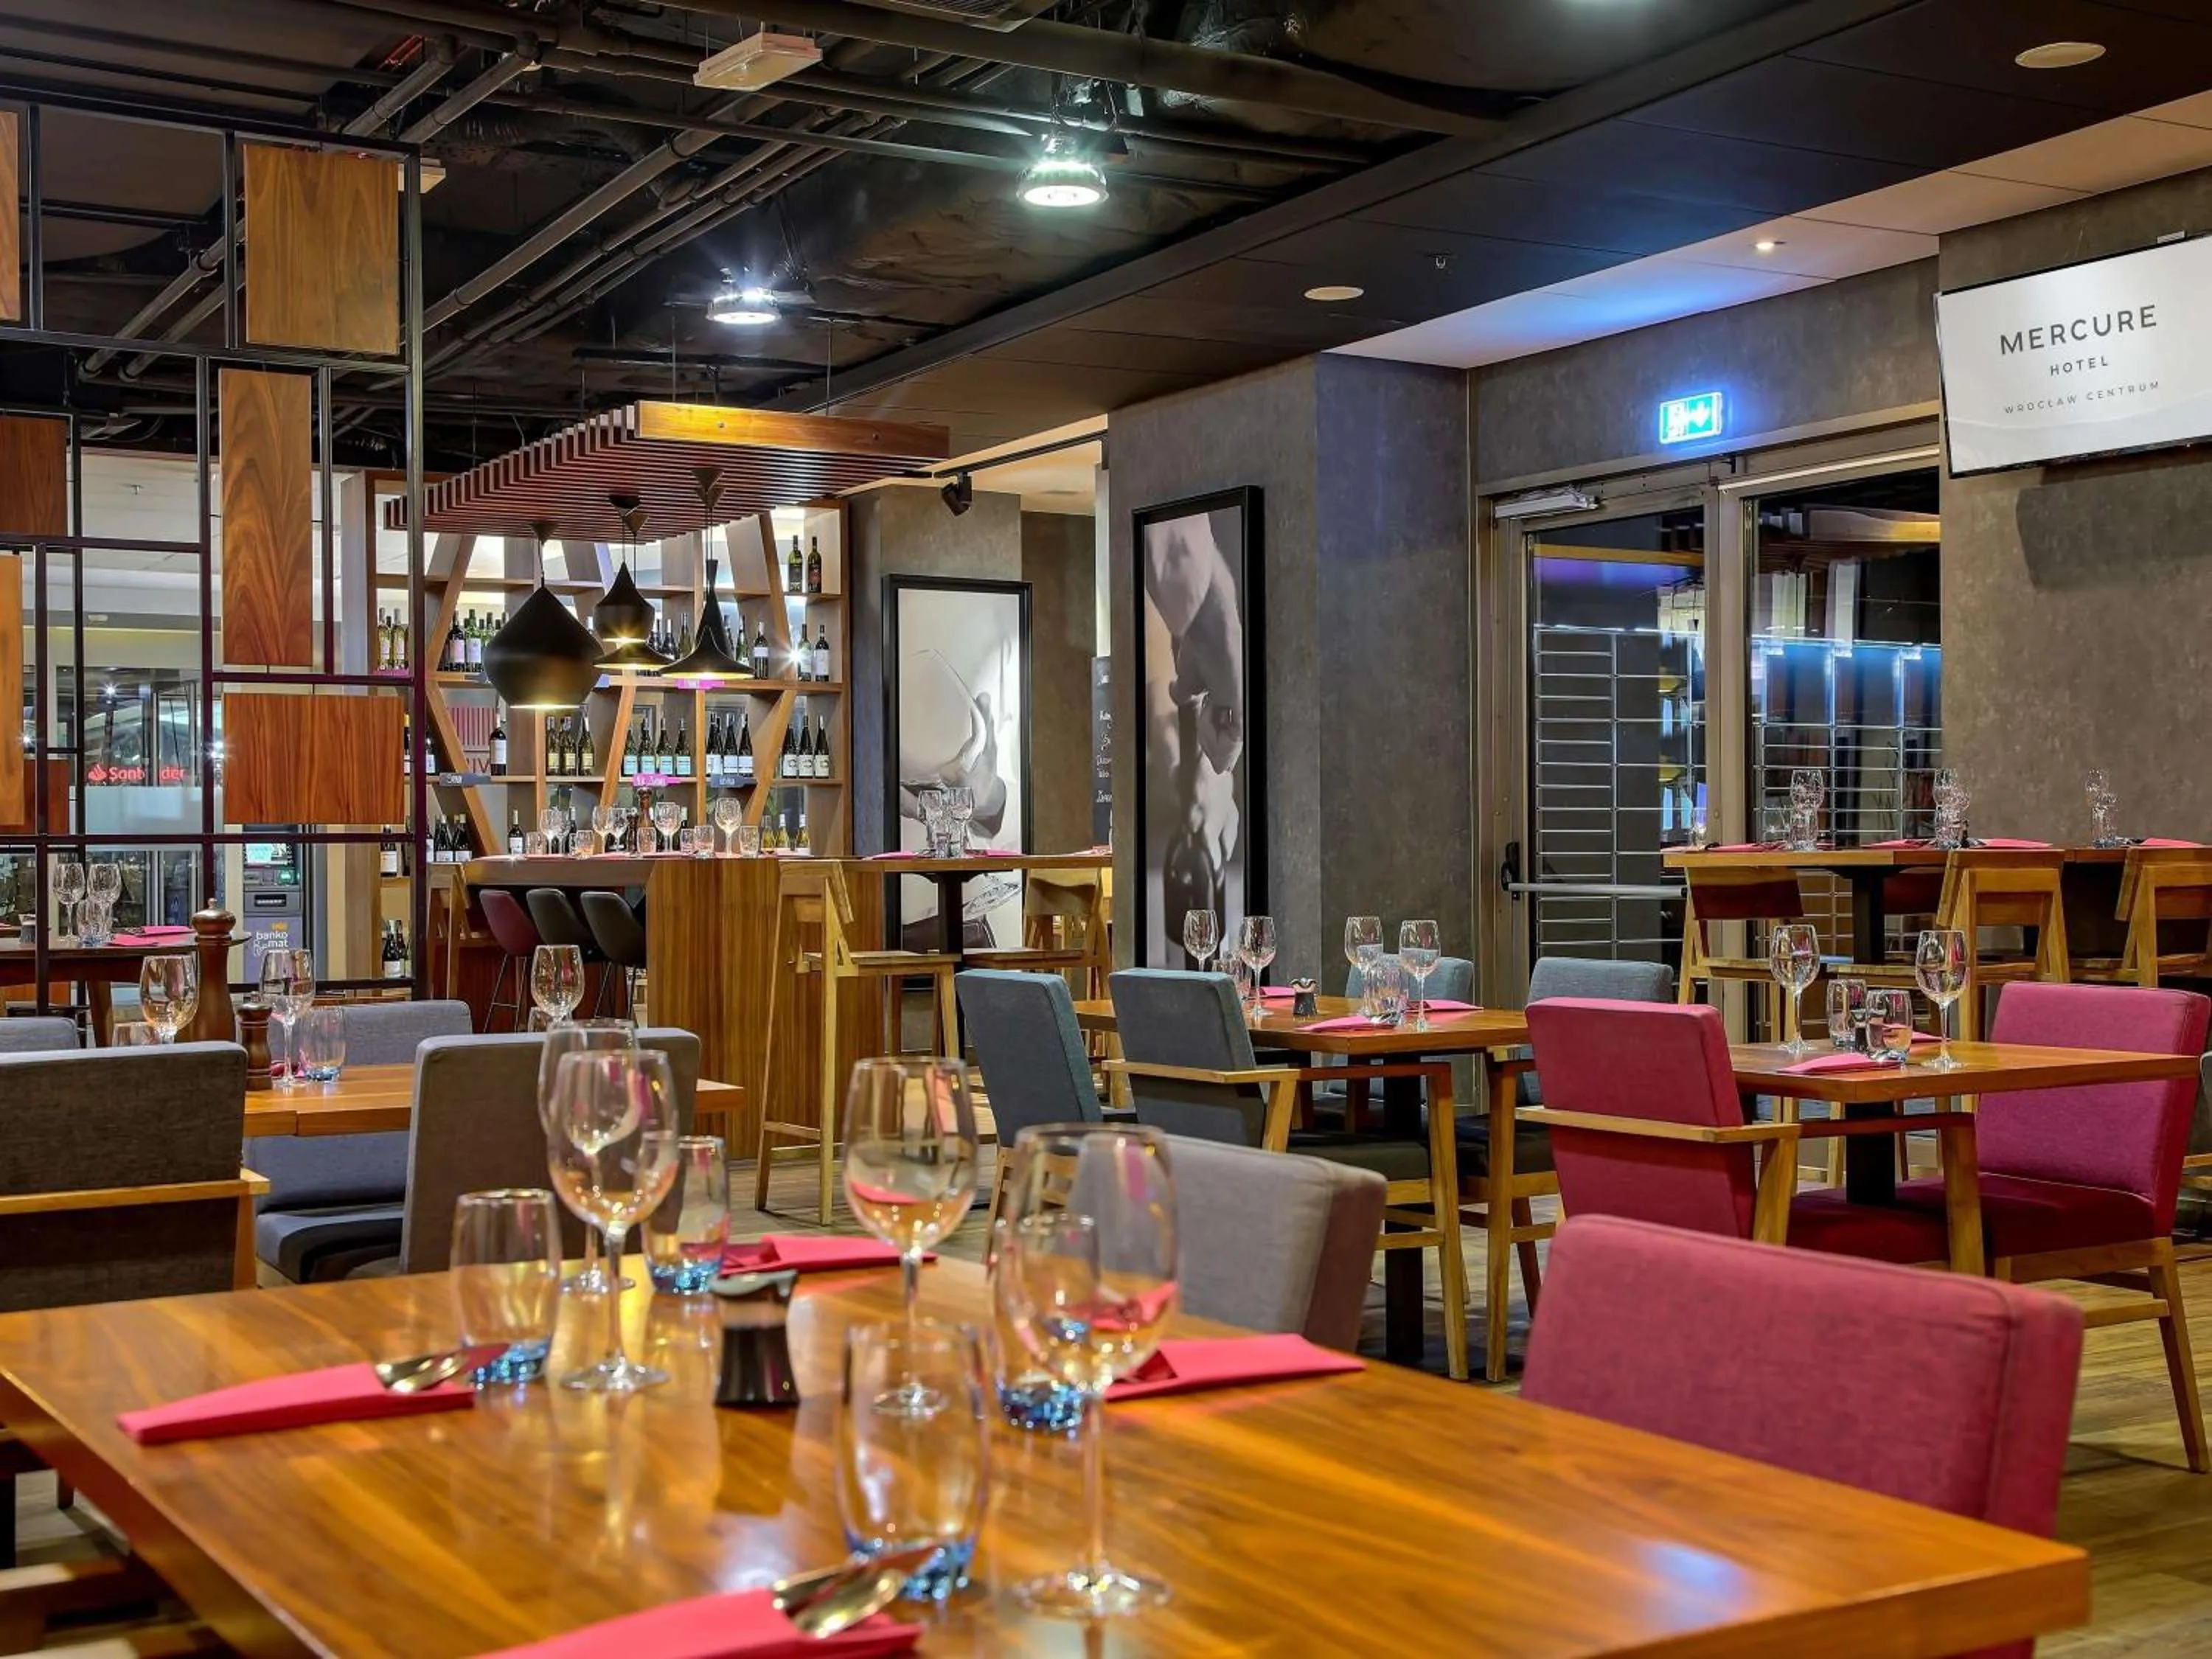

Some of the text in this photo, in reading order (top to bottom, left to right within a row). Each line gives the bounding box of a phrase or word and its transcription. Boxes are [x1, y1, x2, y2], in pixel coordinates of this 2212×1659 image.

[2000, 305, 2157, 355] MERCURE
[2050, 355, 2109, 376] HOTEL
[2086, 381, 2160, 401] CENTRUM
[108, 766, 187, 782] Santder
[268, 939, 289, 948] mat
